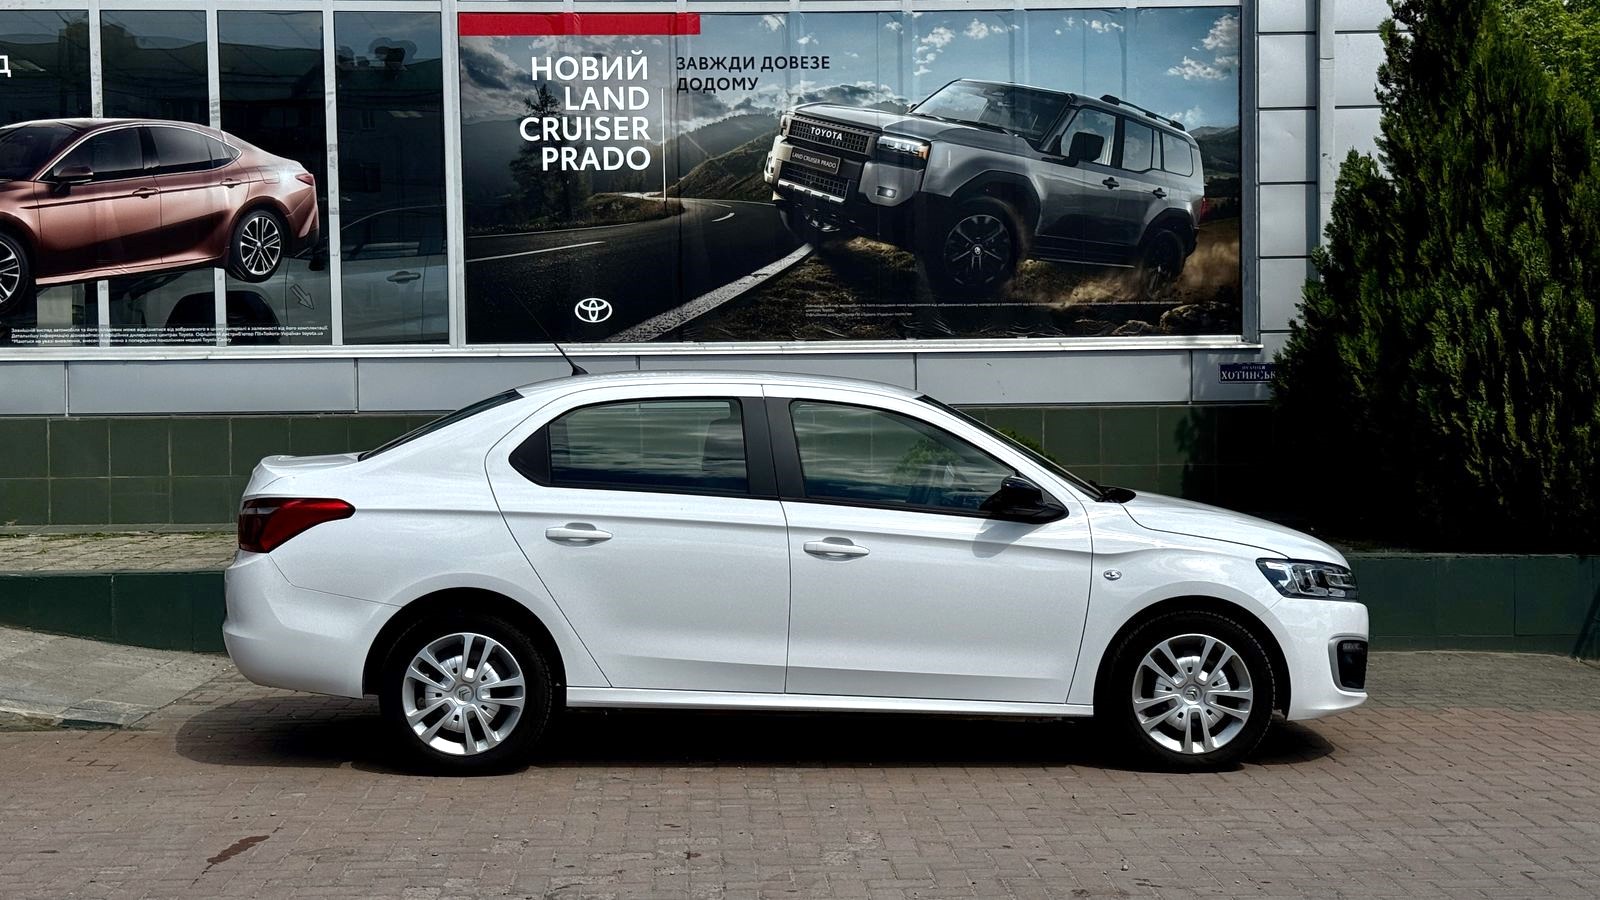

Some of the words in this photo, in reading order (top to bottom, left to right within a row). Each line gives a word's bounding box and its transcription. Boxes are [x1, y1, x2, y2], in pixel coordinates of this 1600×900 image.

[531, 49, 648, 81] НОВИЙ
[676, 56, 755, 73] ЗАВЖДИ
[760, 56, 831, 73] ДОВЕЗЕ
[676, 77, 759, 94] ДОДОМУ
[564, 86, 650, 111] LAND
[519, 116, 651, 141] CRUISER
[810, 126, 843, 141] TOYOTA
[542, 146, 652, 172] PRADO
[820, 160, 837, 169] PRADO
[1221, 370, 1277, 380] ХОТИНСЬК
